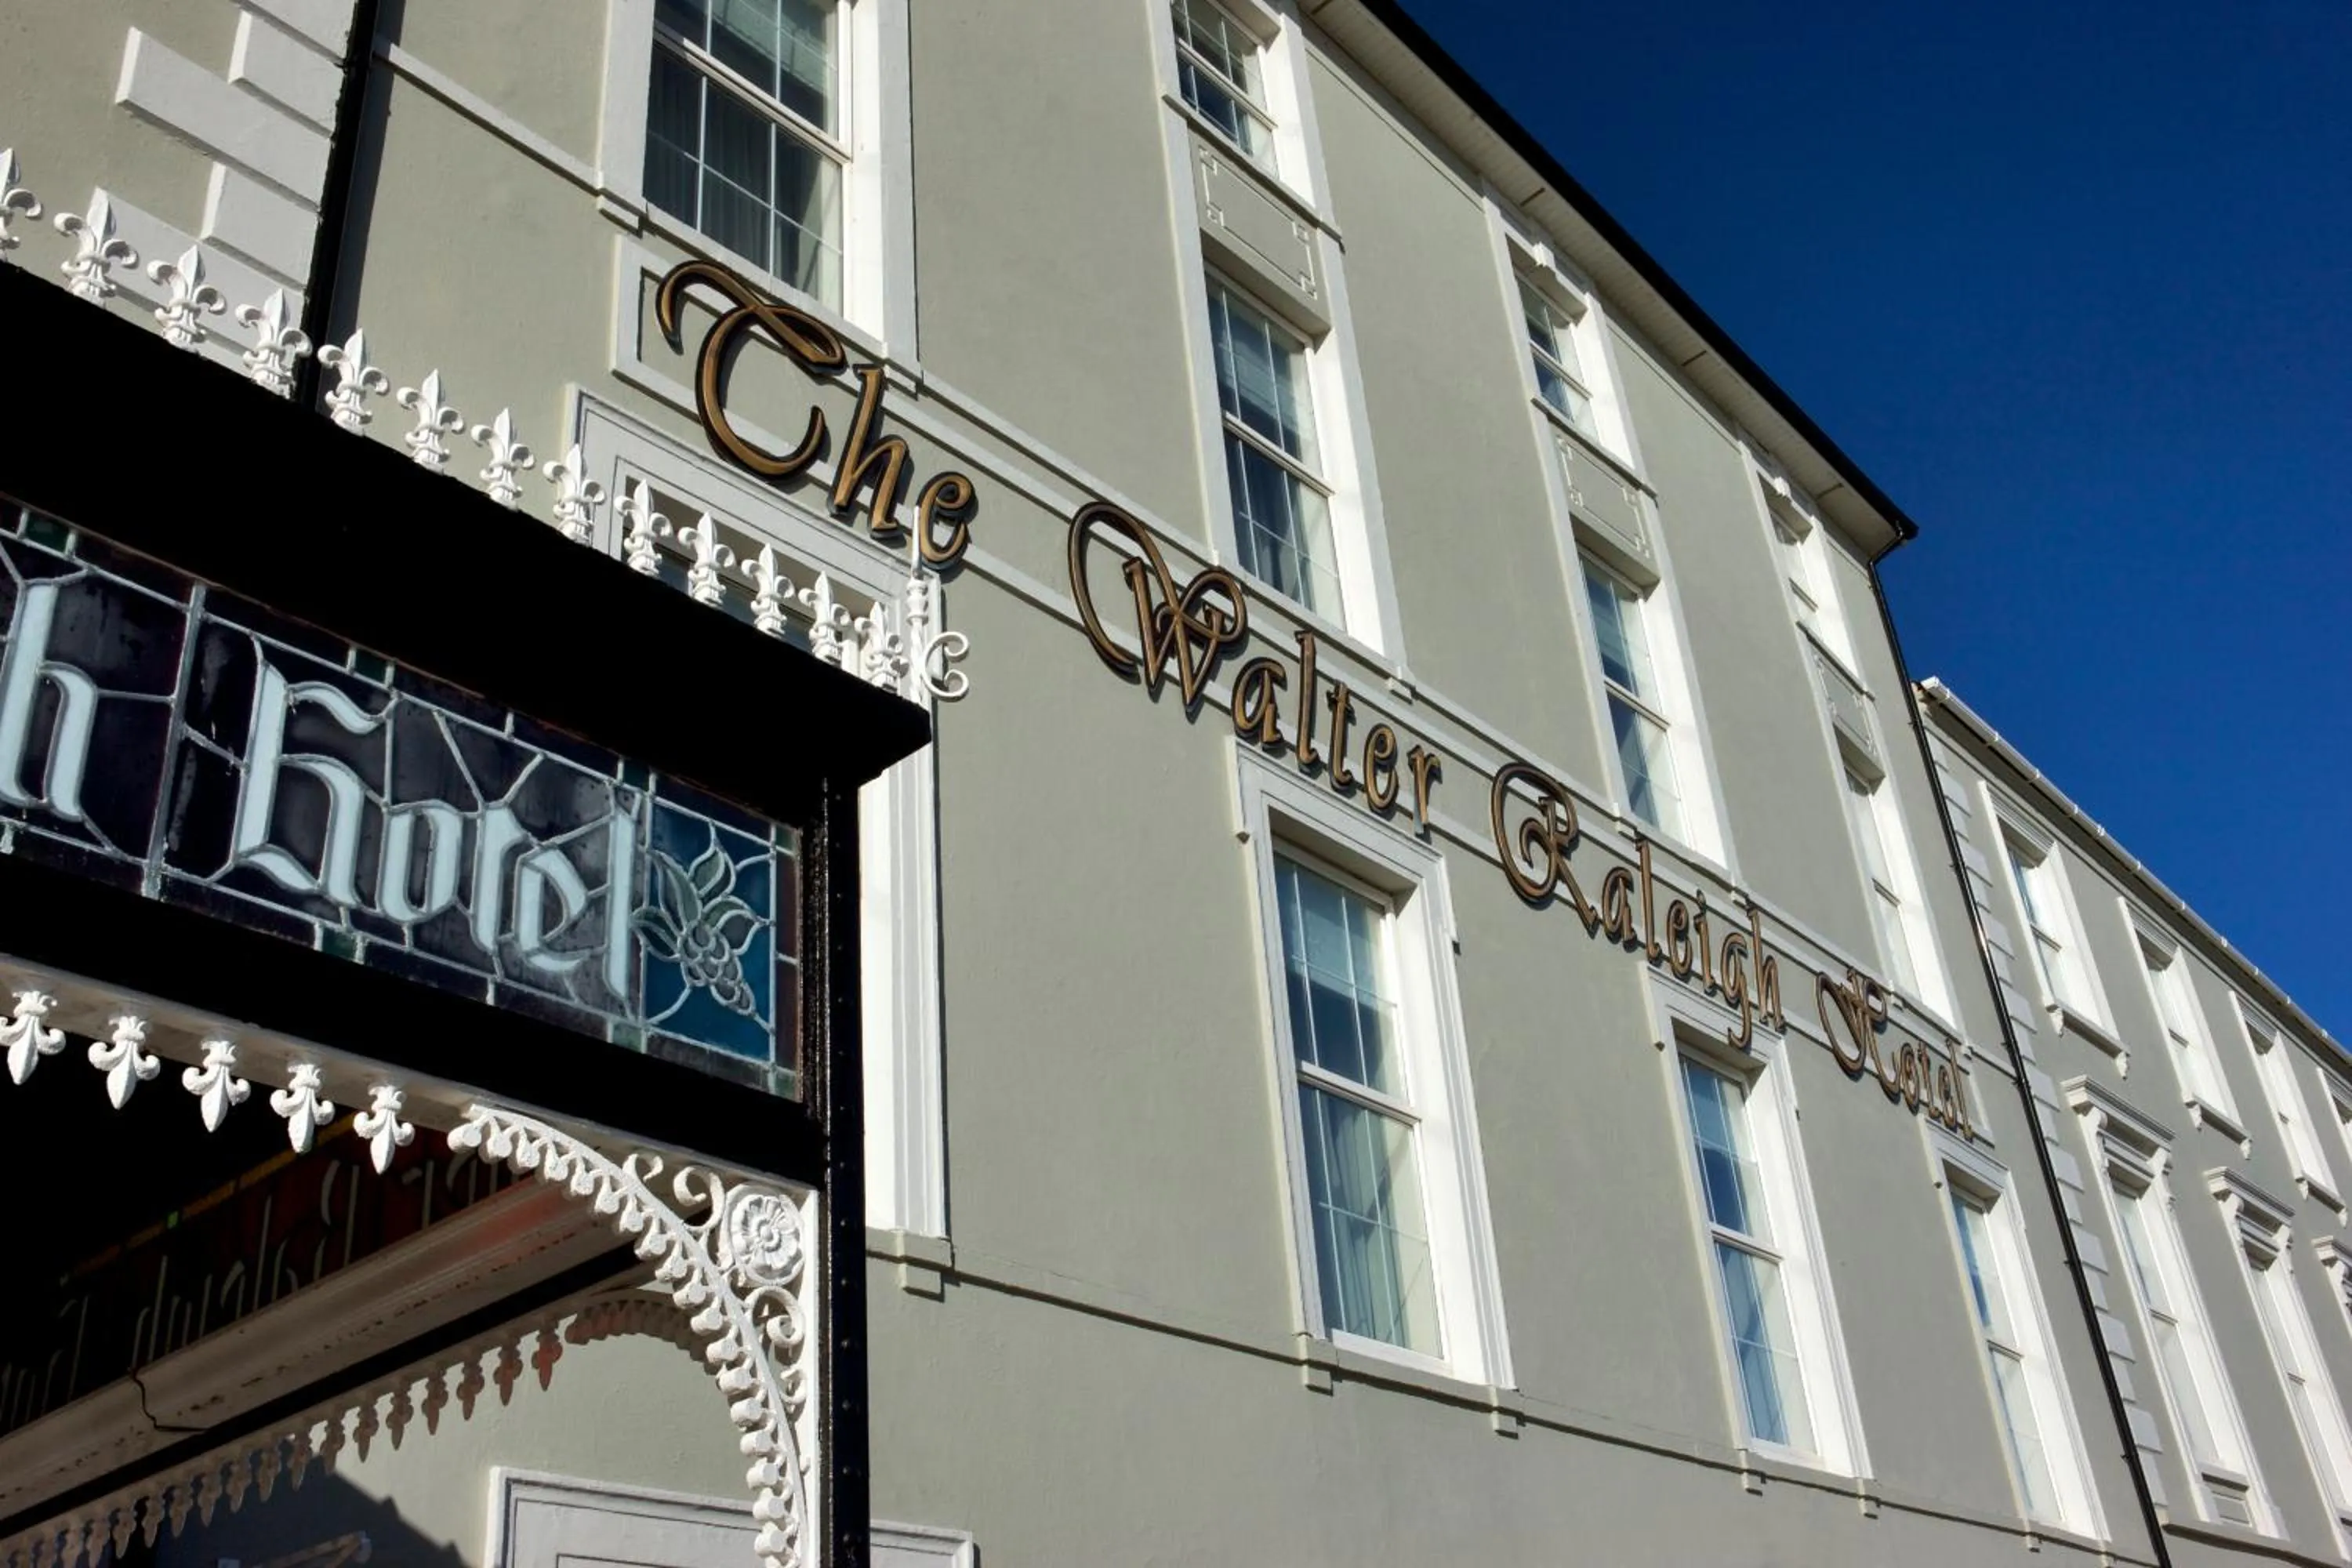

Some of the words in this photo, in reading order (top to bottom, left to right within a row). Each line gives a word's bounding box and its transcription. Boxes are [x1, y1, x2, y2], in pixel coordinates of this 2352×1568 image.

[234, 660, 637, 1000] Hotel
[655, 260, 978, 571] The
[1067, 501, 1443, 833] Walter
[1491, 762, 1786, 1049] Raleigh
[1815, 966, 1974, 1144] Hotel
